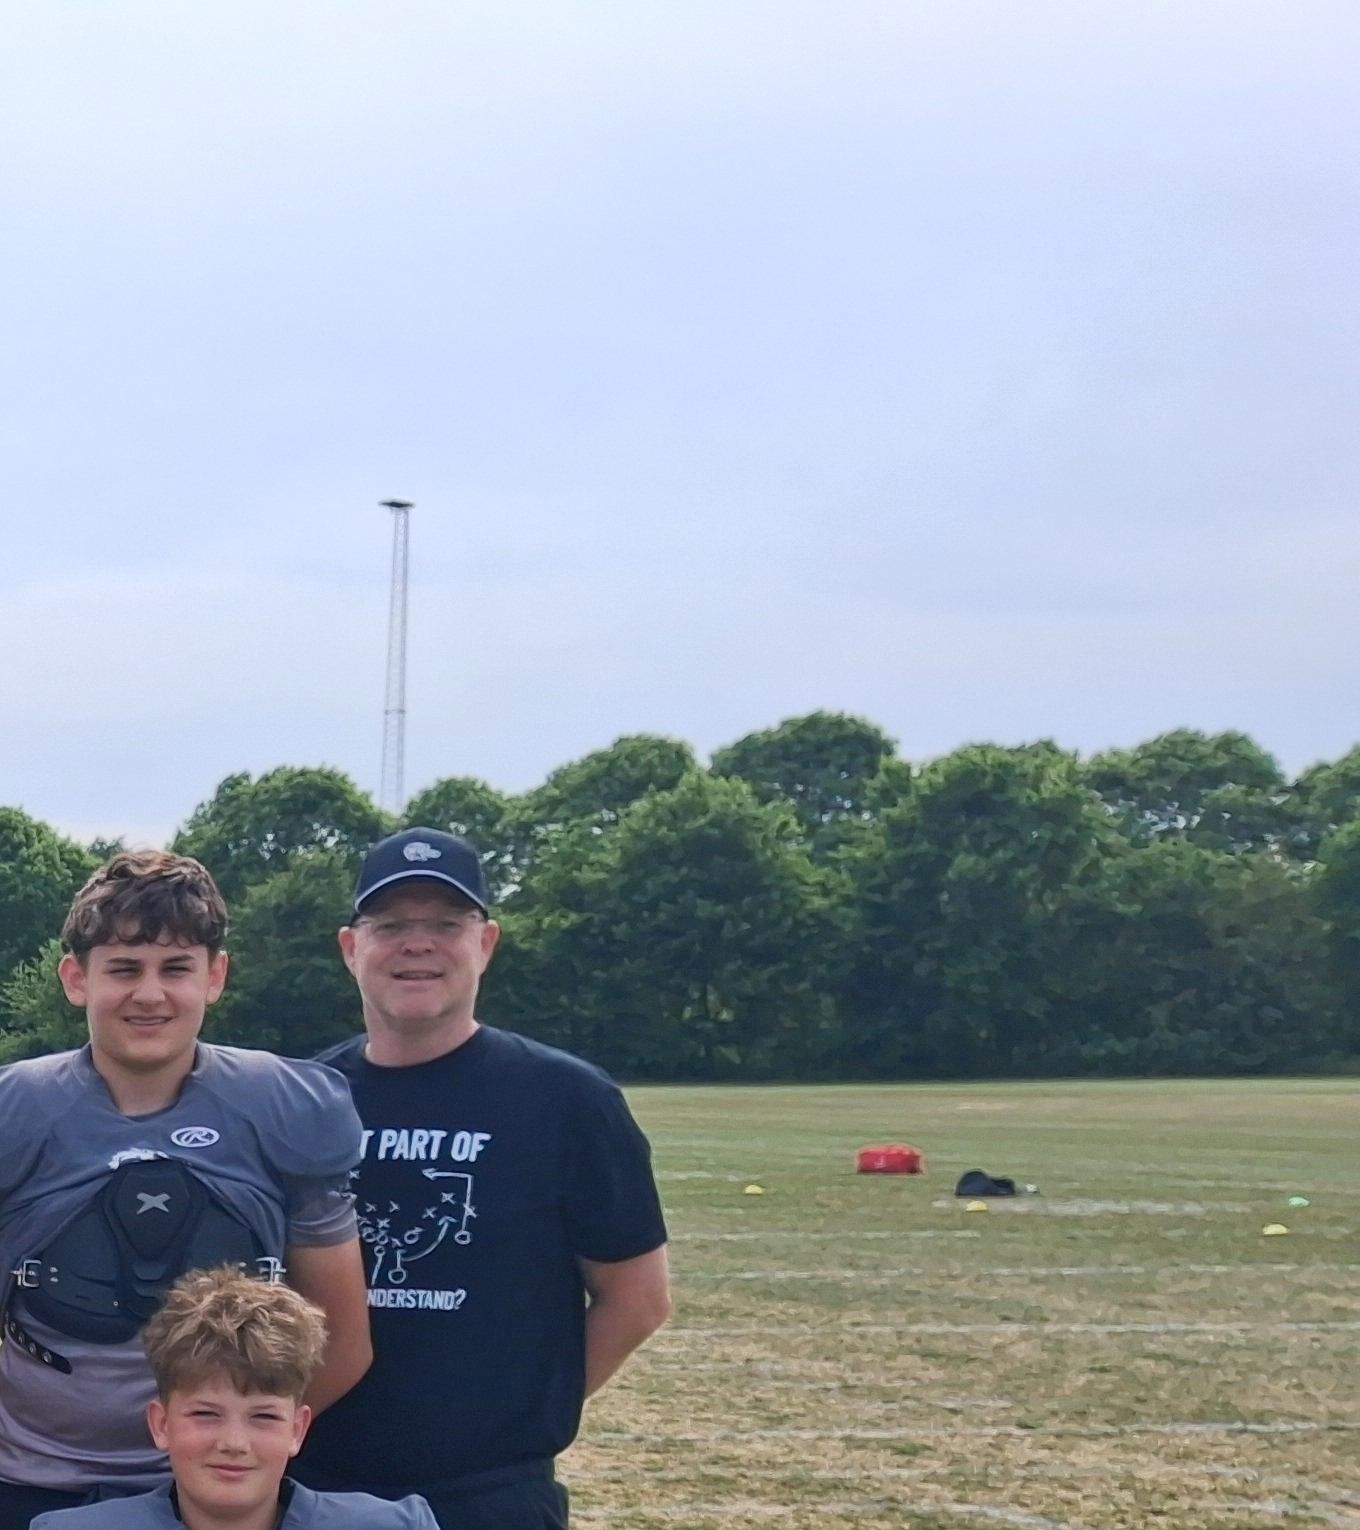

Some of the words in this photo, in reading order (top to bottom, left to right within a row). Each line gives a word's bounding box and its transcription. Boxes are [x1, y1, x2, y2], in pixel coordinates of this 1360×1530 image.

[378, 1129, 448, 1160] PART
[451, 1131, 491, 1162] OF
[366, 1288, 467, 1311] NDERSTAND?
